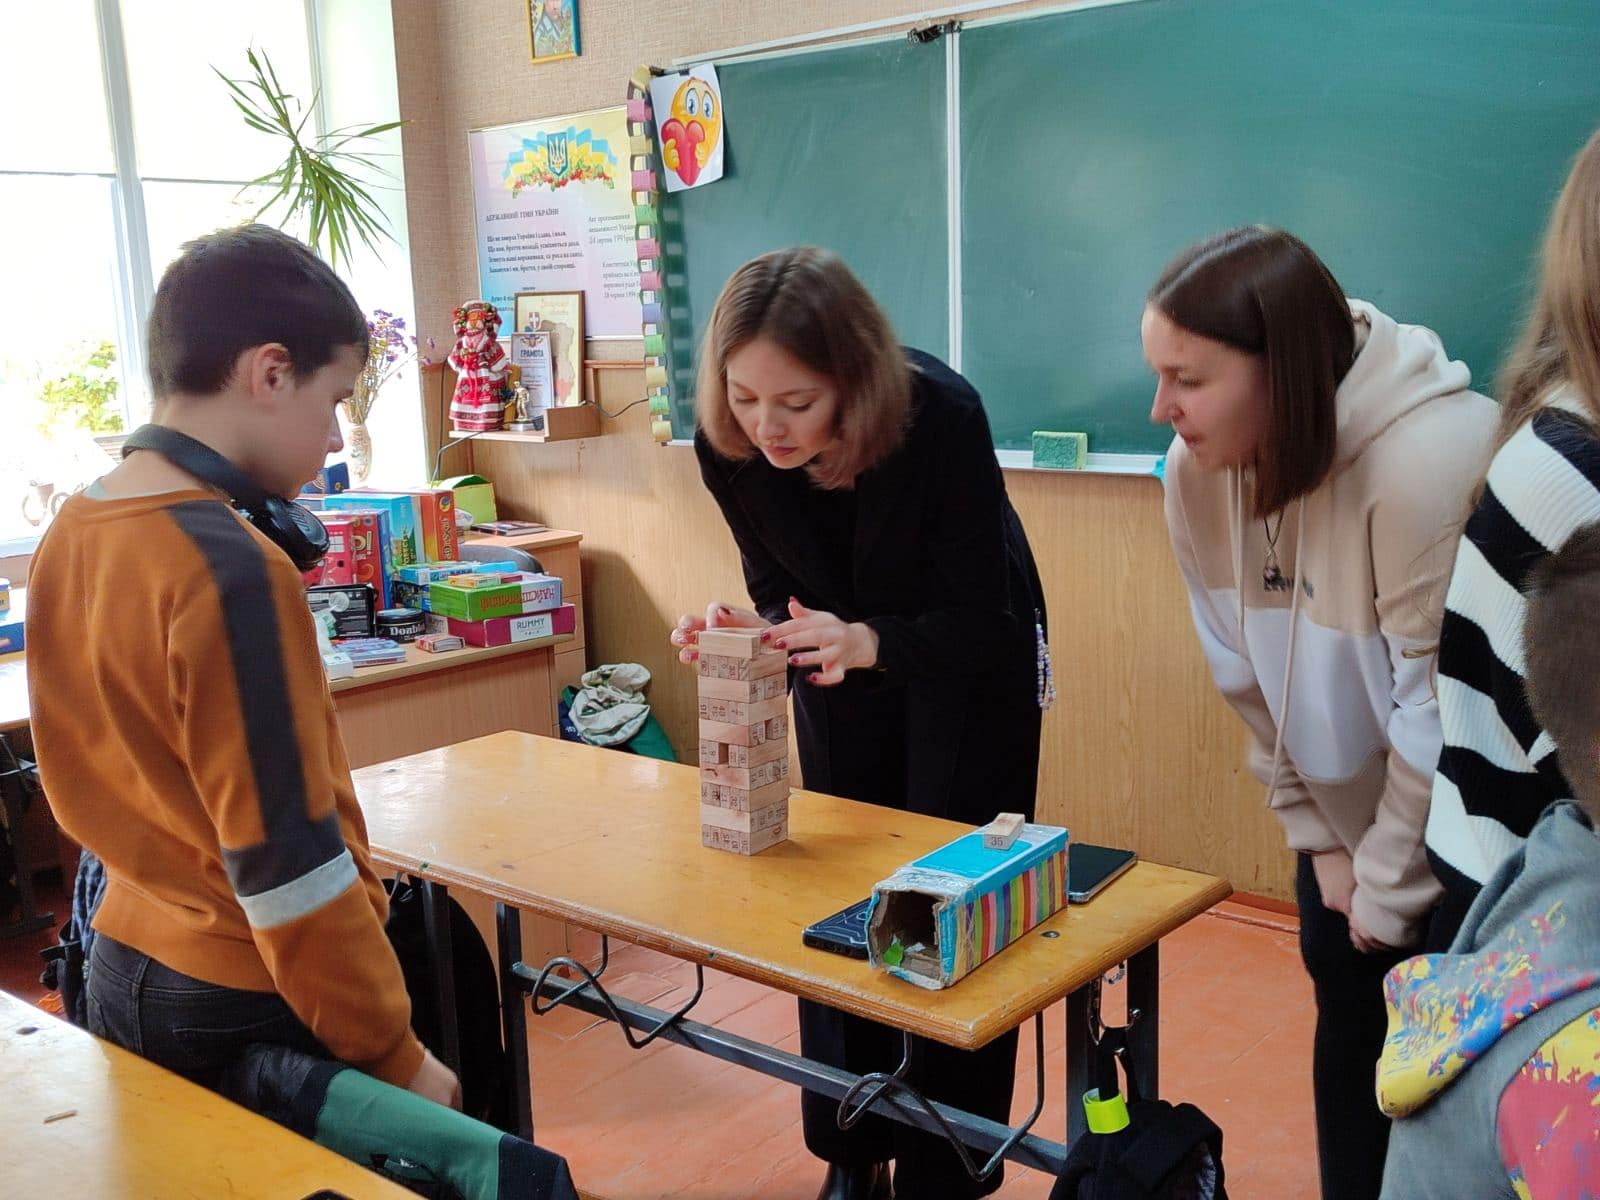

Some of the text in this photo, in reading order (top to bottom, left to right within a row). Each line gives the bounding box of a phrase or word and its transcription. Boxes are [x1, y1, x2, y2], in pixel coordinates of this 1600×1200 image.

[535, 208, 560, 217] УКРАЇНИ
[520, 349, 544, 358] ГРАМОТА
[516, 617, 545, 630] RUMMY
[990, 836, 1004, 847] 35
